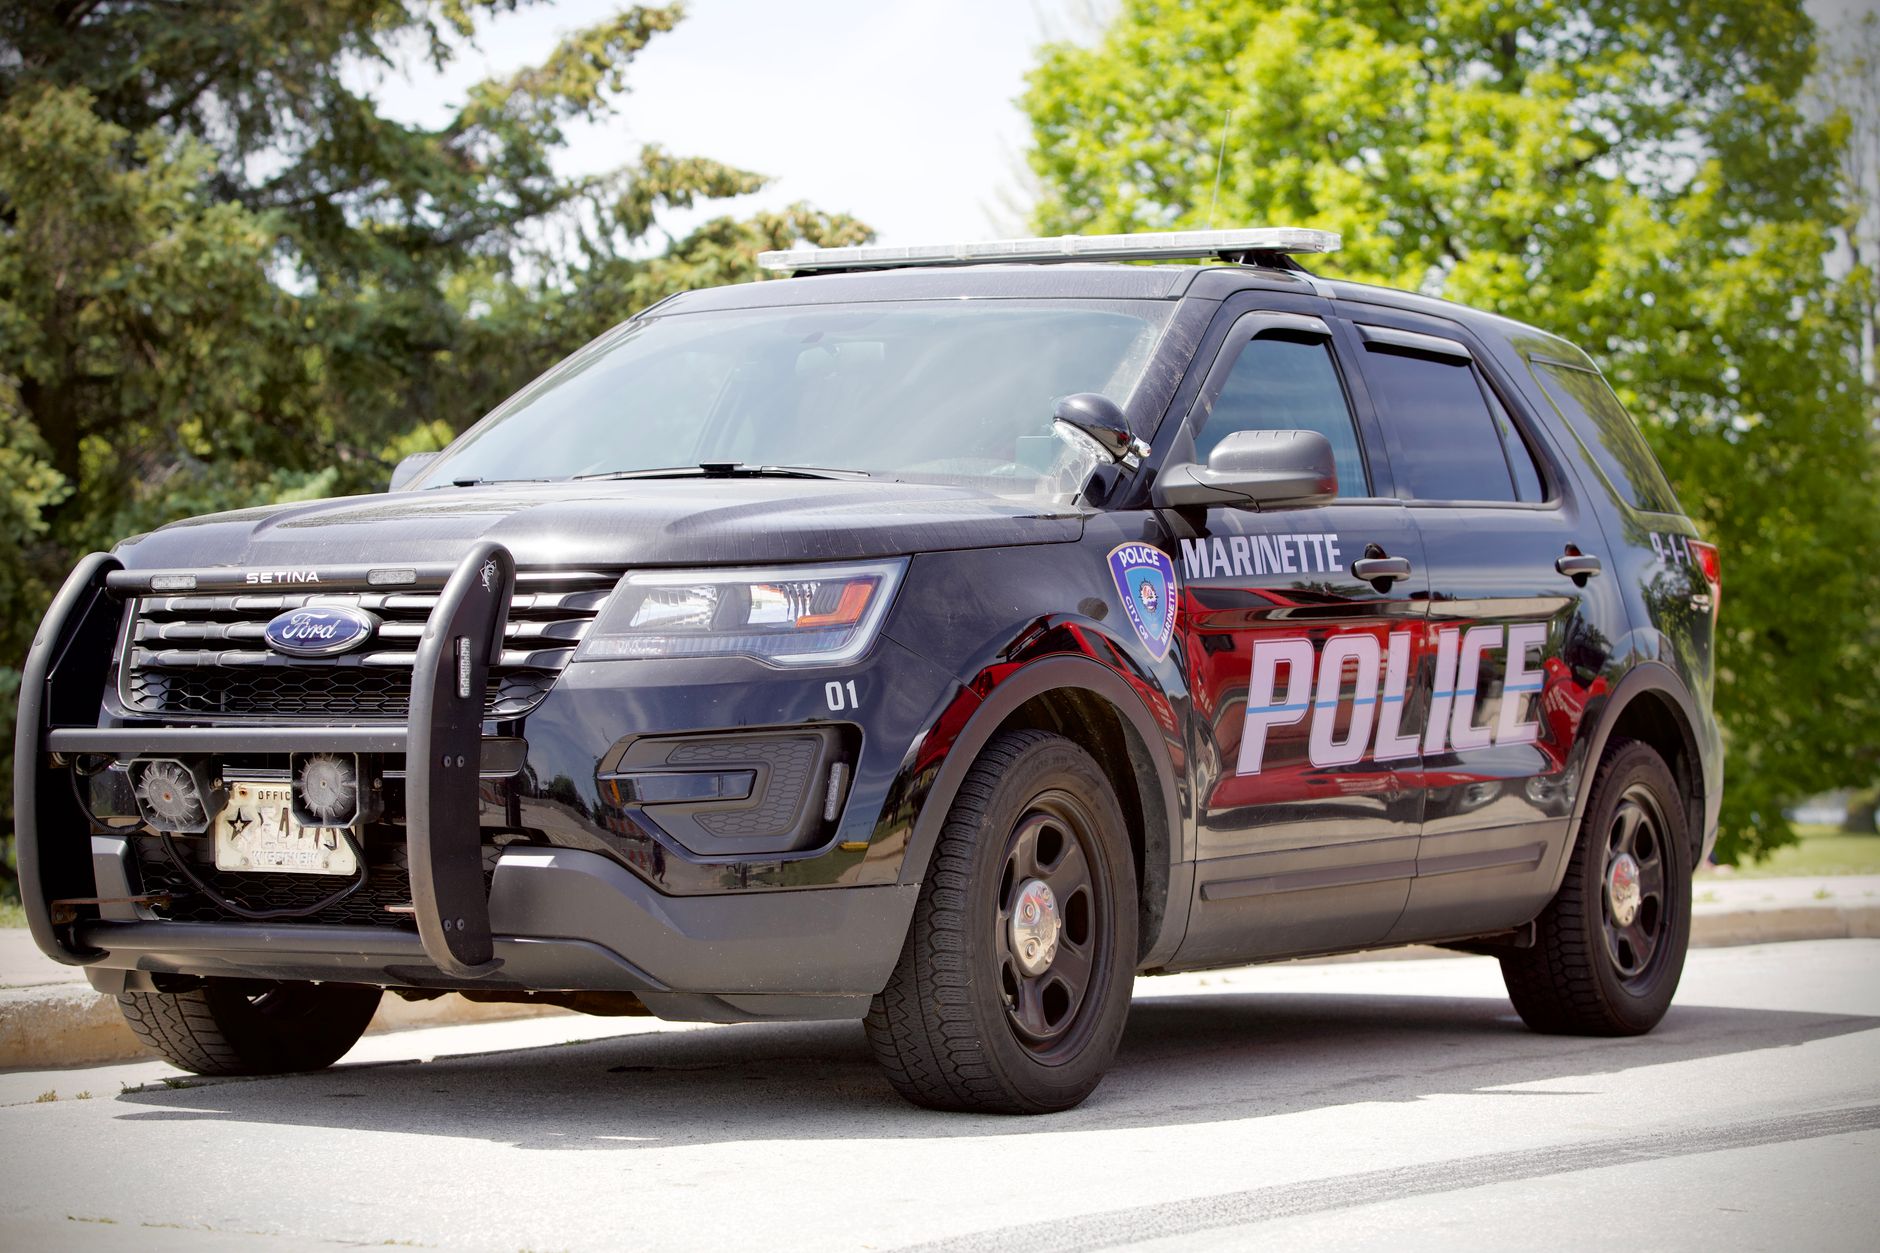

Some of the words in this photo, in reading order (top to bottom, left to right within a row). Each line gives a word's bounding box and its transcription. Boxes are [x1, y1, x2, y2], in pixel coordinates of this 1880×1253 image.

[1118, 547, 1160, 568] POLICE
[1180, 534, 1343, 579] MARINETTE
[1649, 532, 1692, 566] 9-1-1
[246, 571, 319, 584] SETINA
[282, 612, 341, 639] Ford
[1125, 595, 1140, 622] CITY
[1139, 624, 1149, 640] OF
[1161, 582, 1174, 646] MARINETTE
[825, 680, 859, 711] 01
[1236, 623, 1547, 776] POLICE
[258, 790, 291, 801] OFFIC
